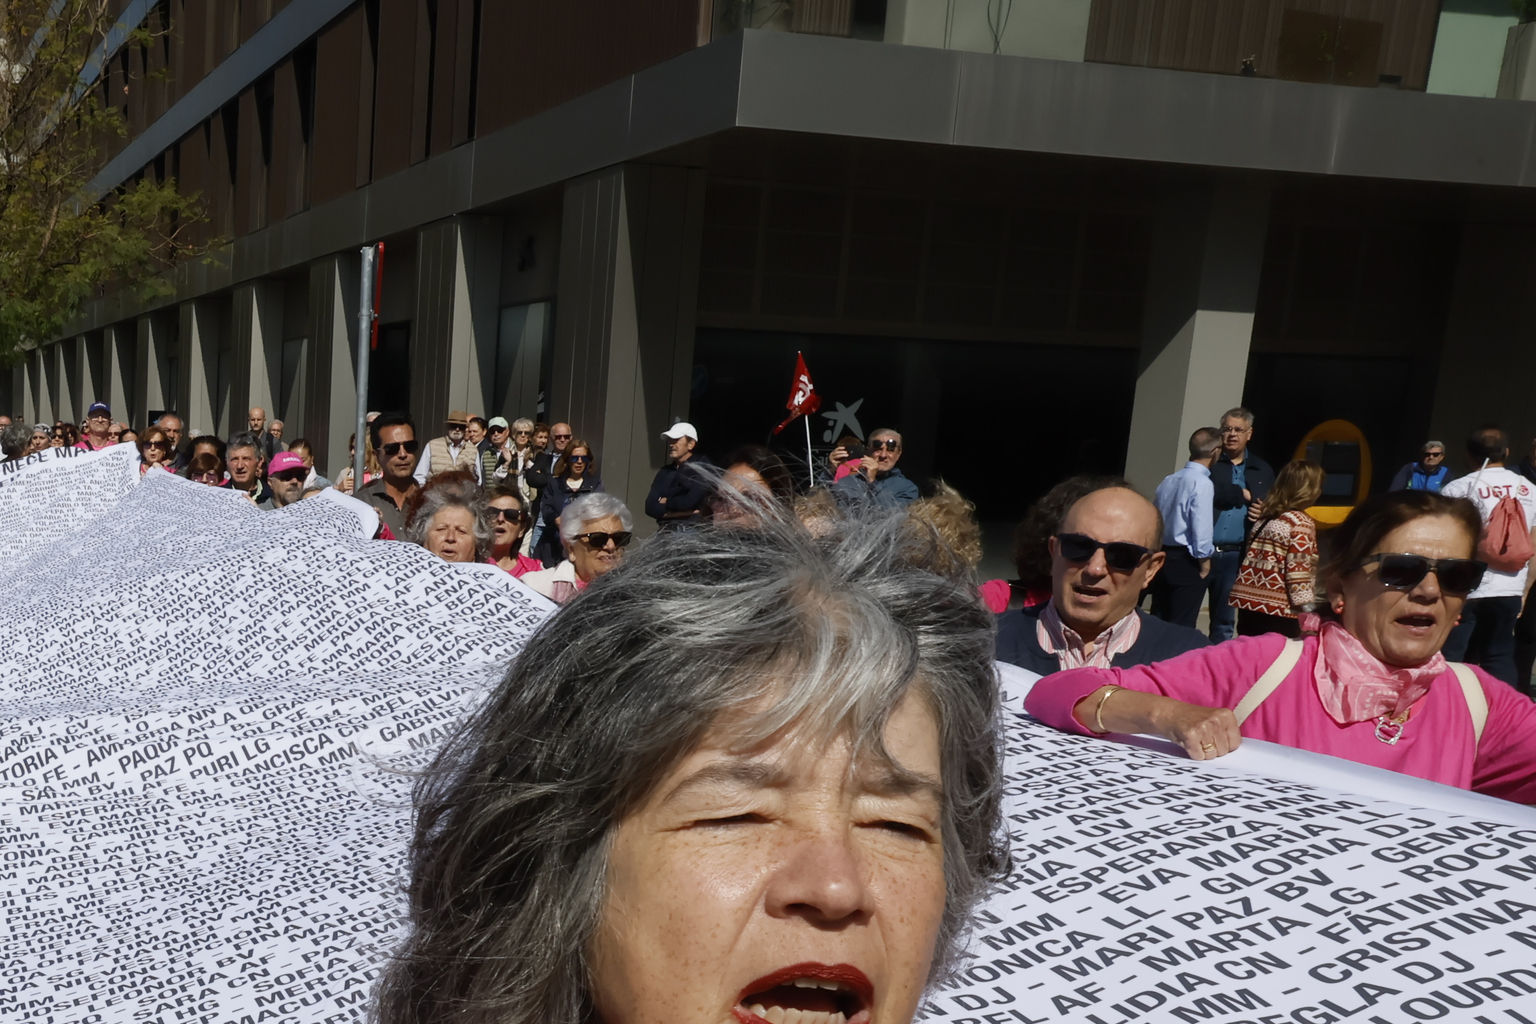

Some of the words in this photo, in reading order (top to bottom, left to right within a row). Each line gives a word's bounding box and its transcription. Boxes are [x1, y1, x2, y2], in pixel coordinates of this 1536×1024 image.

[1478, 485, 1512, 499] UGT
[271, 609, 341, 662] CRISTINA
[140, 756, 181, 782] PAZ
[189, 750, 240, 780] PURI
[213, 732, 334, 782] FRANCISCA
[1008, 780, 1186, 824] MICAELA
[1074, 812, 1242, 859] TERESA
[1239, 793, 1329, 813] MM
[1032, 819, 1279, 904] ESPERANZA
[1275, 800, 1367, 821] MM
[1098, 866, 1192, 904] EVA
[1186, 823, 1343, 871] MARÍA
[1335, 811, 1405, 825] LL
[1171, 896, 1271, 930] PAZ
[1264, 868, 1335, 902] BV
[1371, 821, 1518, 863] GEMA
[1200, 837, 1370, 895] GLORIA
[1364, 817, 1437, 839] DJ
[1139, 916, 1312, 972] MARTA
[1301, 887, 1378, 917] LG
[1214, 951, 1293, 980] CN
[1316, 878, 1510, 944] FÁTIMA
[1391, 950, 1476, 985] DJ
[1168, 988, 1273, 1024] MM
